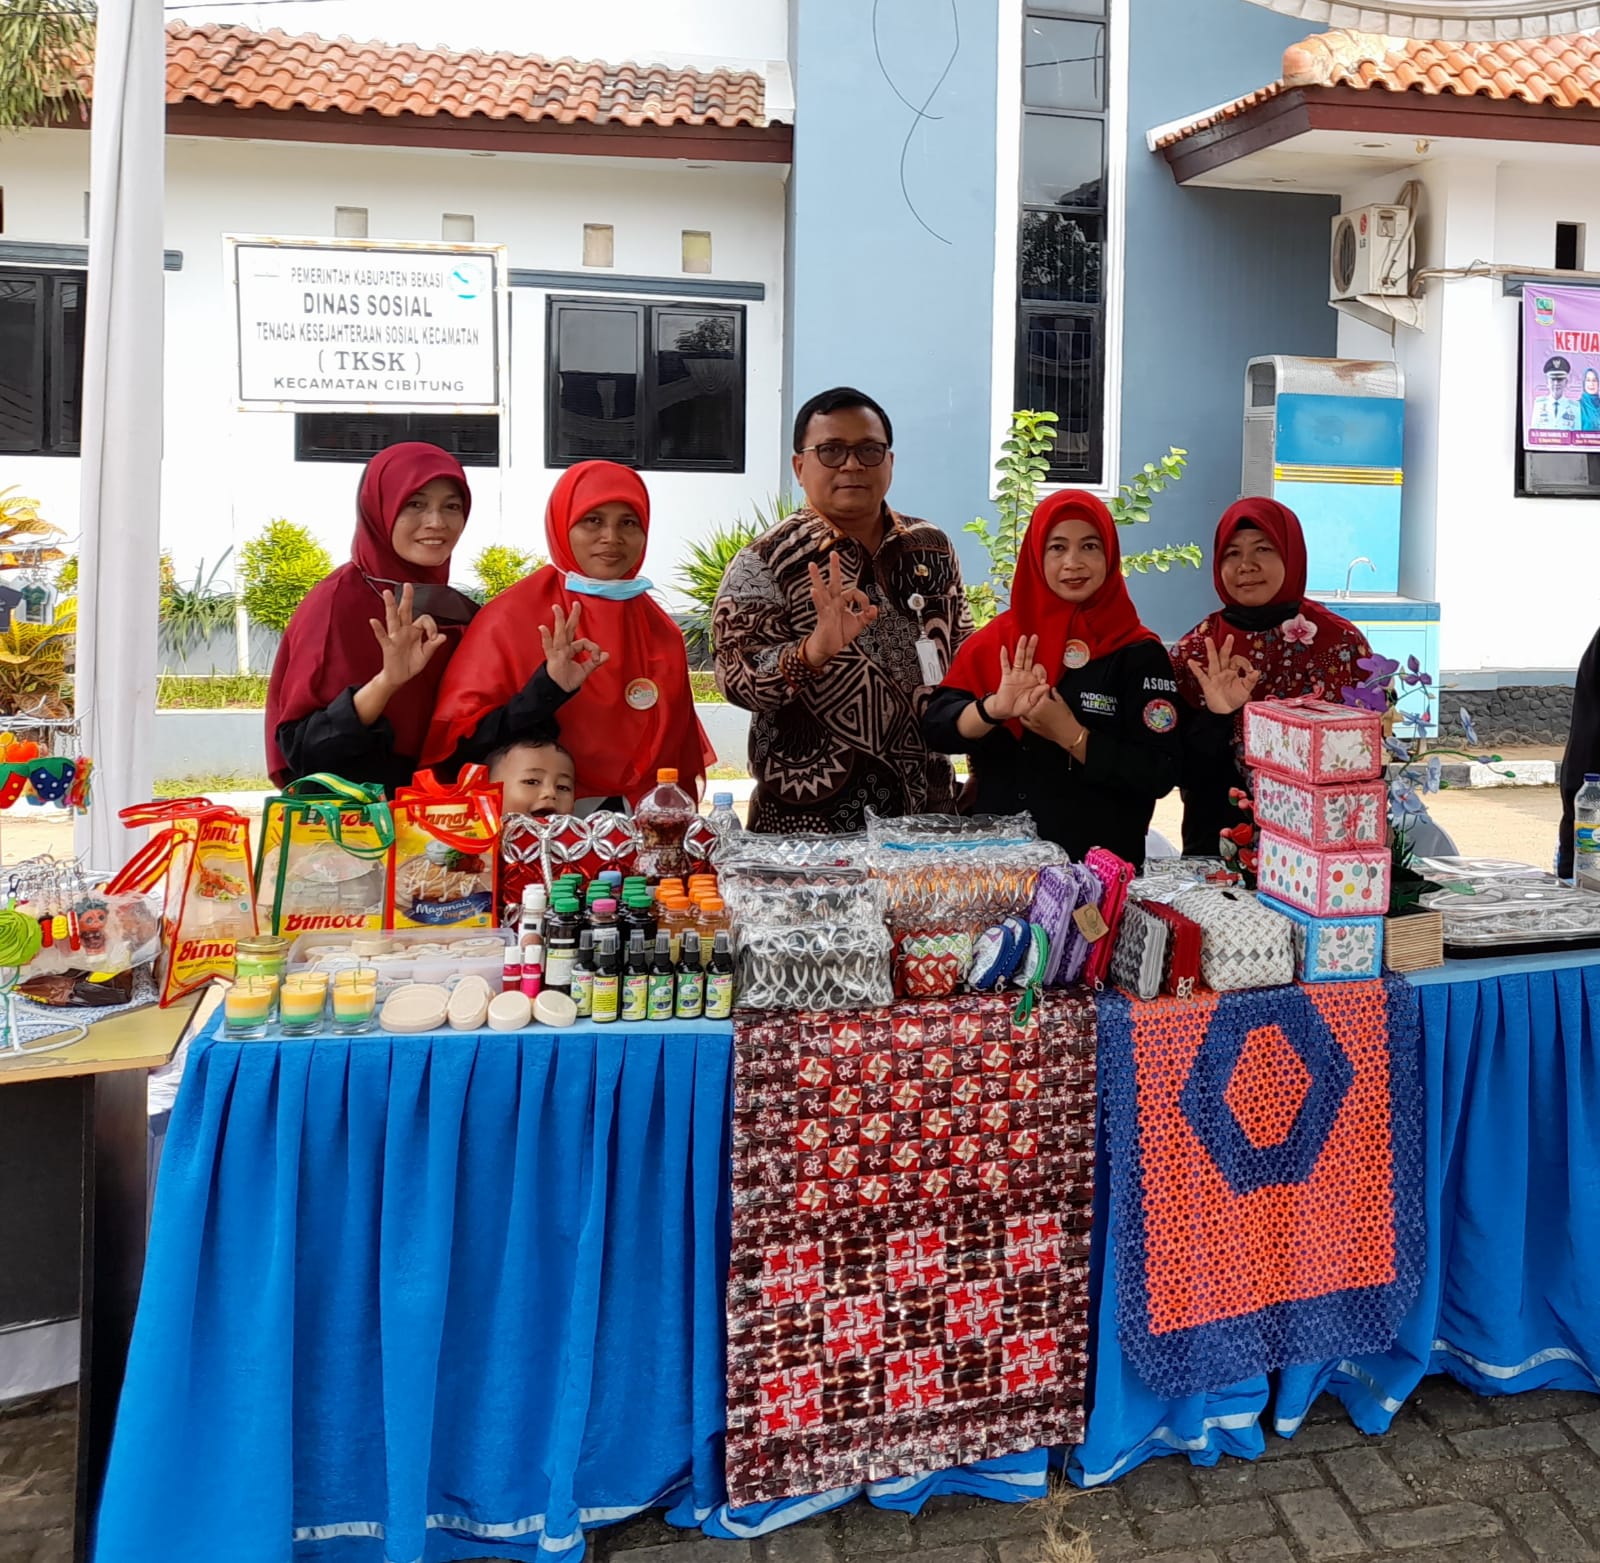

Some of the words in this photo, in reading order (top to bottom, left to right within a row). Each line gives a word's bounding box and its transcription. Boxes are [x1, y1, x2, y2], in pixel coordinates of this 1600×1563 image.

[291, 267, 350, 284] PEMERINTAH
[353, 269, 408, 287] KABUPATEN
[411, 272, 443, 288] BEKASI
[303, 292, 360, 316] DINAS
[367, 295, 433, 317] SOSIAL
[256, 322, 296, 342] TENAGA
[300, 323, 382, 343] KESEJAHTERAAN
[385, 326, 419, 345] SOSIAL
[422, 327, 479, 346] KECAMATAN
[1555, 331, 1600, 352] KETUA
[274, 377, 378, 391] KECAMATAN
[384, 379, 465, 392] CIBITUNG
[1143, 677, 1177, 692] ASOBS
[177, 939, 237, 962] Bimo
